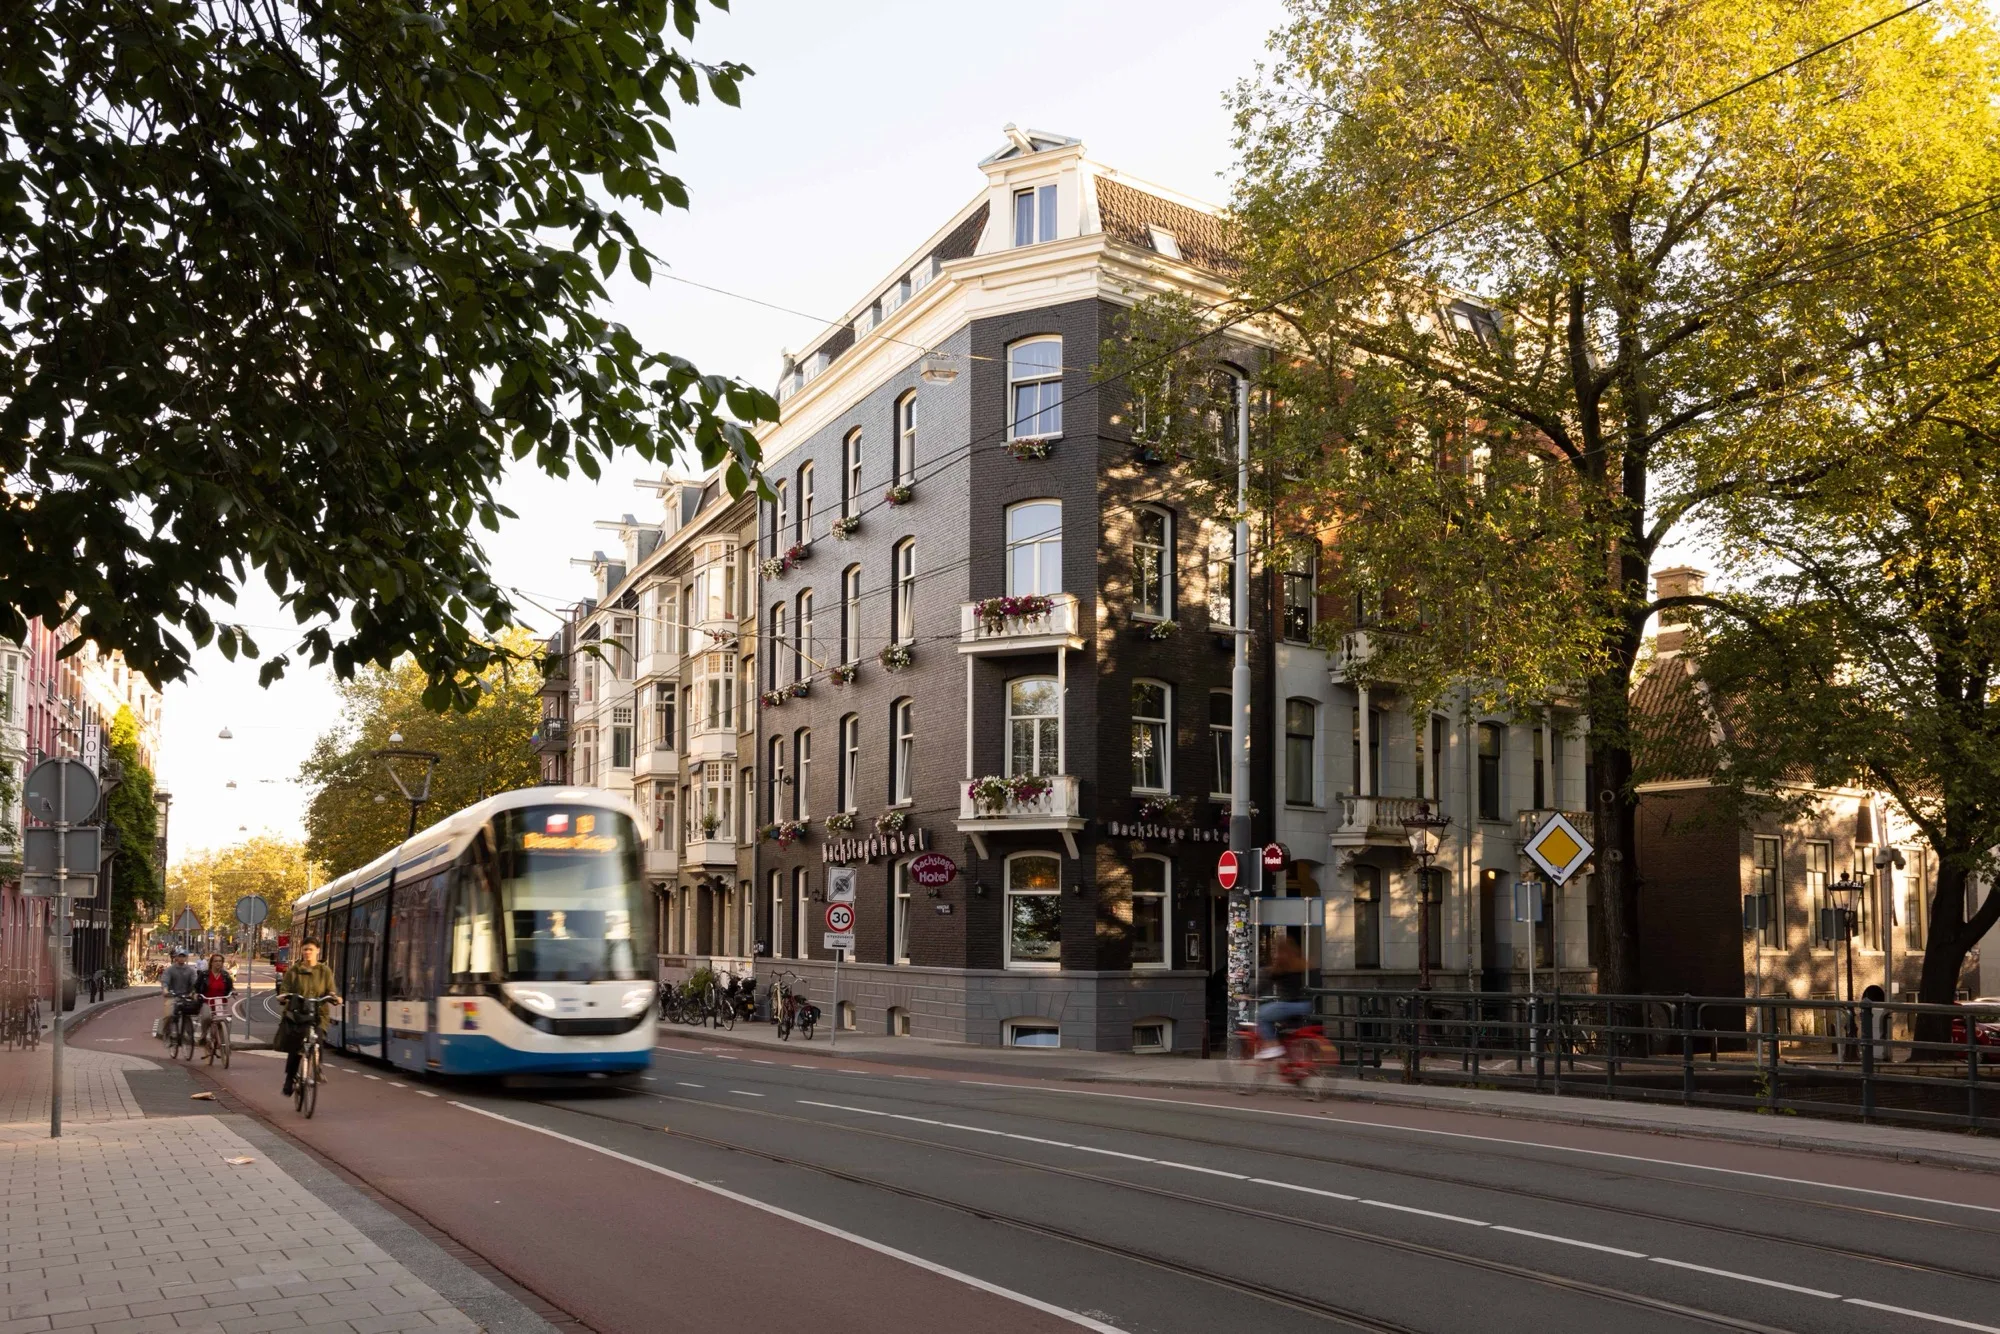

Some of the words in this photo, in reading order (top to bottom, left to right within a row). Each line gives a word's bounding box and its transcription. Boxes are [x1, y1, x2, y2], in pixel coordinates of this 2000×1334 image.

[86, 726, 96, 766] HOT
[880, 827, 924, 855] Hotel
[1193, 828, 1230, 843] Hote
[919, 870, 949, 882] Hotel
[832, 912, 850, 924] 30
